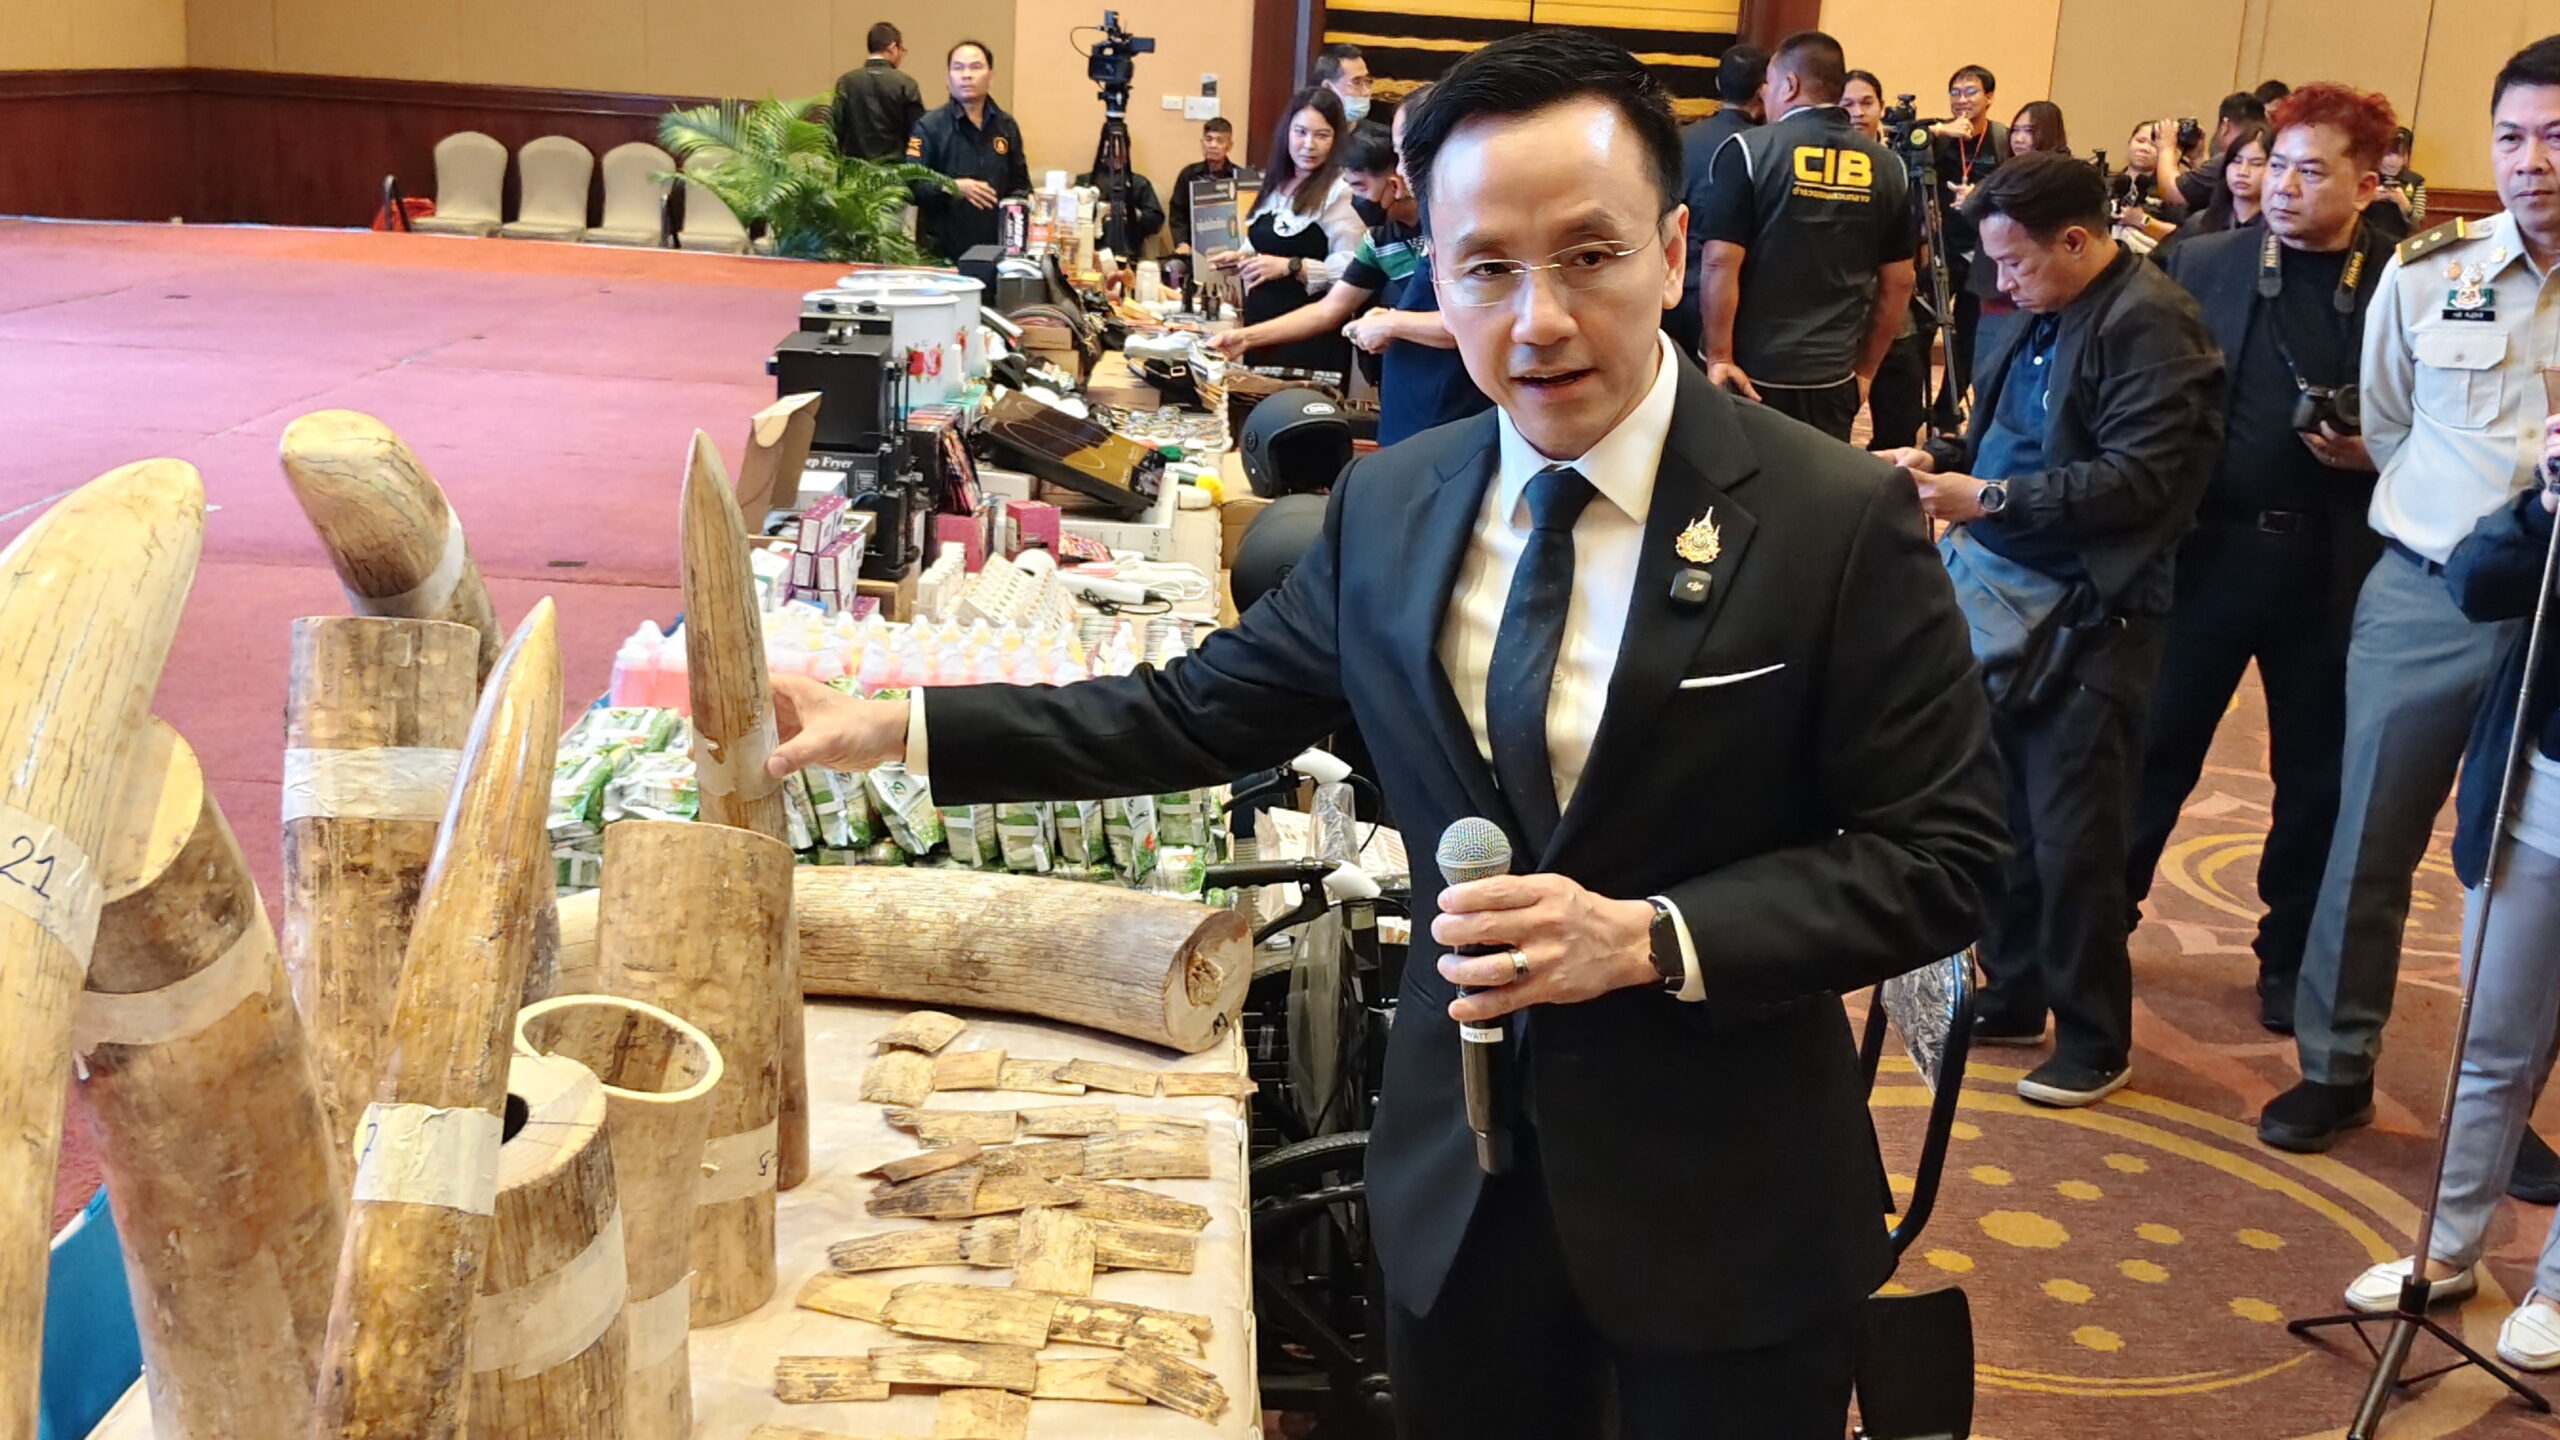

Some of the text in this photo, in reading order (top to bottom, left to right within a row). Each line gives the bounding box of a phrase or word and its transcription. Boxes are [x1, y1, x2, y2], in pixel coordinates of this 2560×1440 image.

[1793, 146, 1872, 187] CIB
[2343, 250, 2366, 288] Nikon
[820, 456, 854, 470] Fryer
[0, 834, 56, 902] 21
